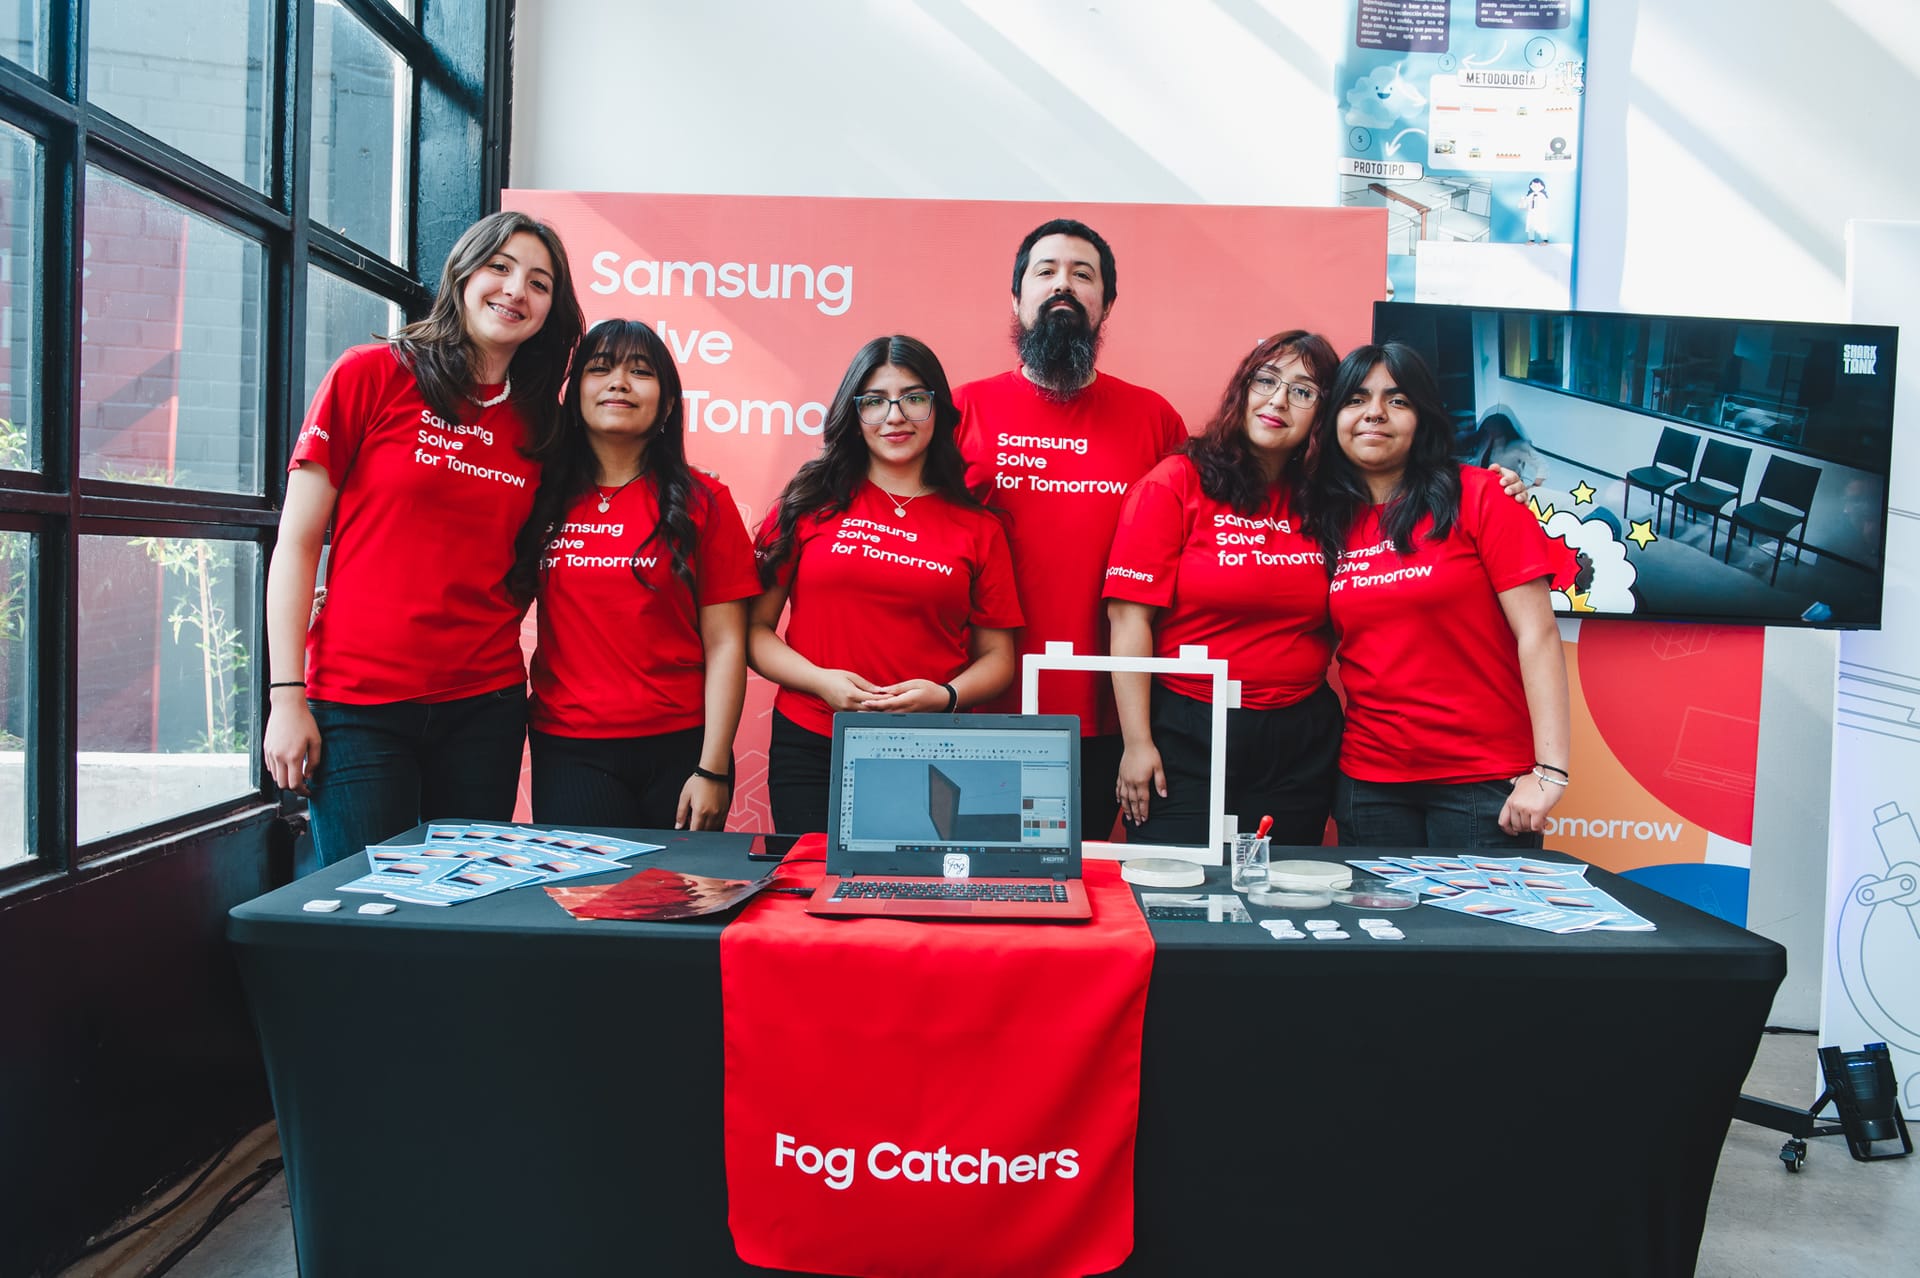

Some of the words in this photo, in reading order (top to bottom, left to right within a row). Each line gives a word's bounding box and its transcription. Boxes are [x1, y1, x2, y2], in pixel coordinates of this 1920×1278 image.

[1536, 48, 1543, 57] 4
[1466, 71, 1536, 86] METODOLOGÍA
[1357, 135, 1364, 144] 5
[1354, 160, 1405, 176] PROTOTIPO
[589, 251, 853, 316] Samsung
[1843, 344, 1877, 360] SHARK
[1843, 358, 1876, 375] TANK
[683, 389, 828, 436] Tomo
[417, 429, 464, 451] Solve
[997, 432, 1088, 455] Samsung
[414, 448, 441, 467] for
[445, 454, 526, 489] Tomorrow
[996, 452, 1048, 469] Solve
[995, 471, 1024, 489] for
[1027, 474, 1128, 495] Tomorrow
[836, 529, 881, 543] Solve
[841, 517, 918, 542] Samsung
[1216, 532, 1266, 546] Solve
[565, 553, 658, 568] Tomorrow
[831, 541, 857, 555] for
[862, 544, 953, 576] Tomorrow
[1217, 549, 1248, 567] for
[1251, 550, 1326, 566] Tomorro
[1351, 565, 1433, 589] Tomorrow
[1543, 815, 1683, 842] omorrow
[775, 1132, 856, 1190] Fog
[867, 1141, 1080, 1185] Catchers
